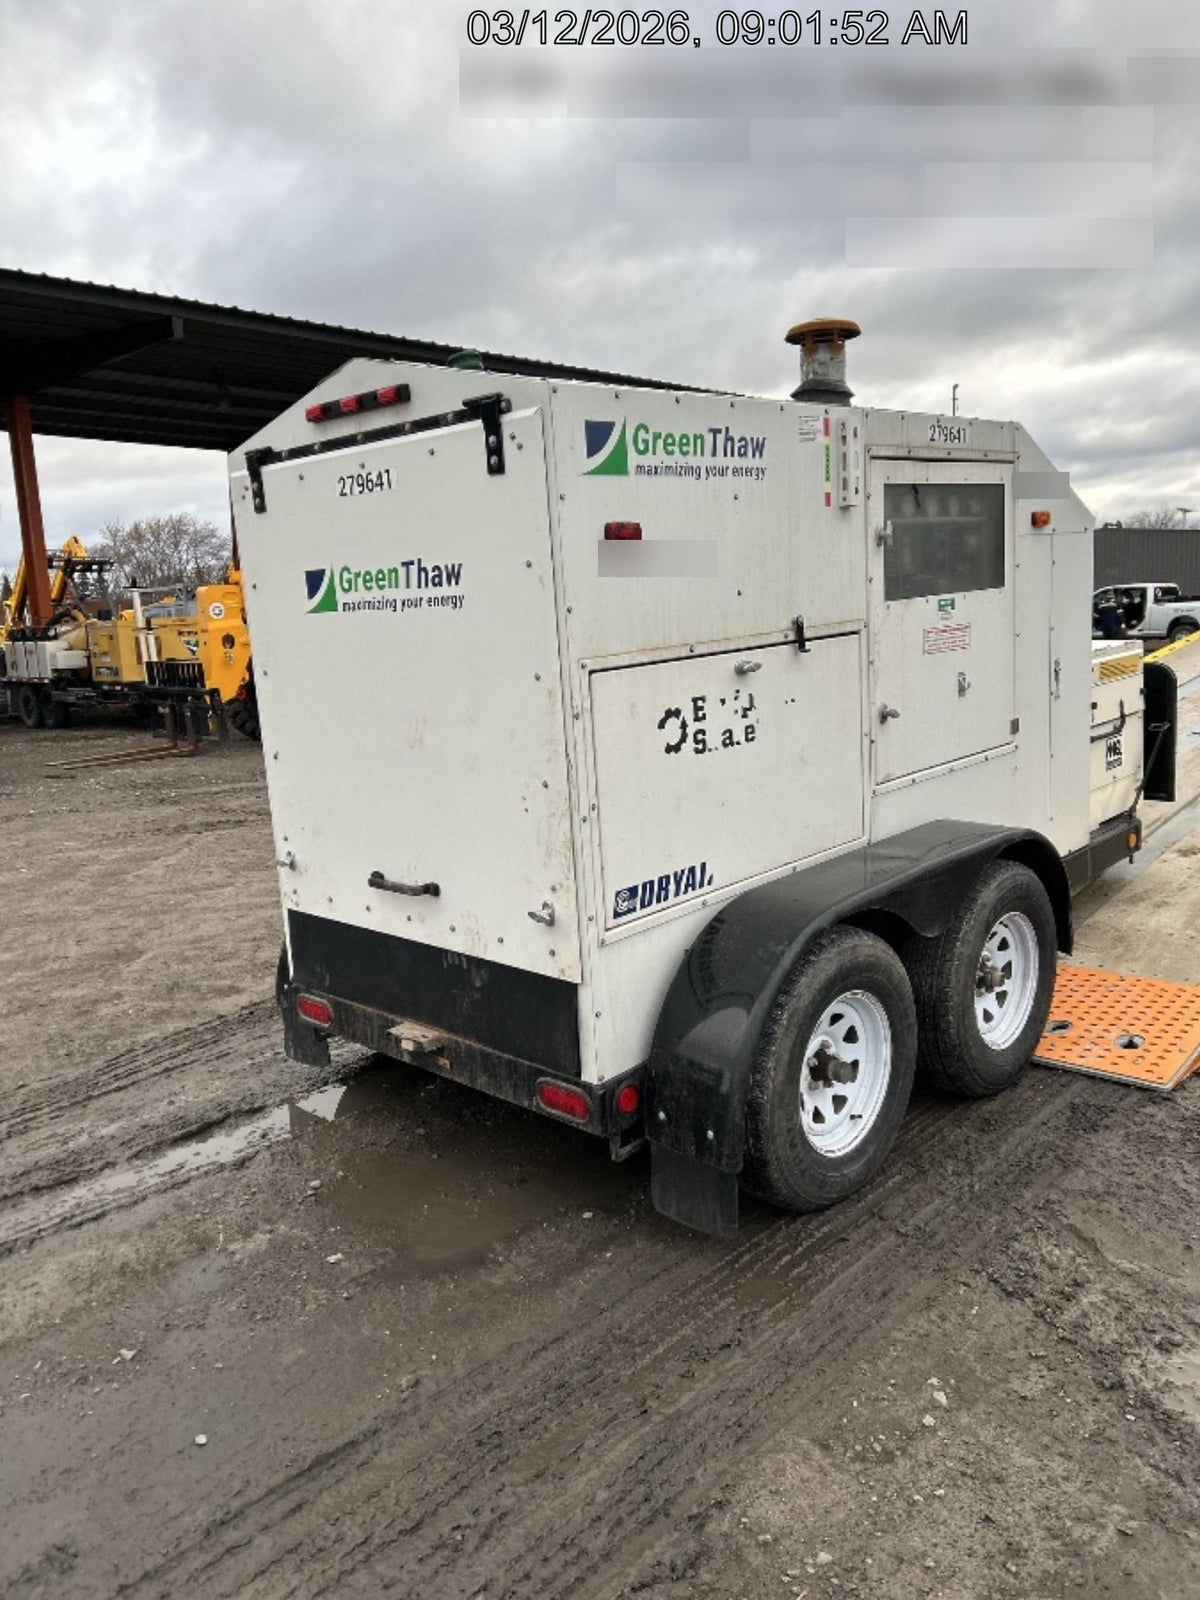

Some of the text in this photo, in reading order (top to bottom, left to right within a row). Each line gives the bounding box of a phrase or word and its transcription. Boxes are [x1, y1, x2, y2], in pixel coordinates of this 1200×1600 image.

[632, 422, 767, 459] GreenThaw
[929, 424, 967, 444] 279641
[337, 468, 392, 497] 279641
[634, 461, 767, 481] maximizing your energy
[338, 557, 463, 594] GreenThaw
[341, 594, 465, 613] maximizing your energy
